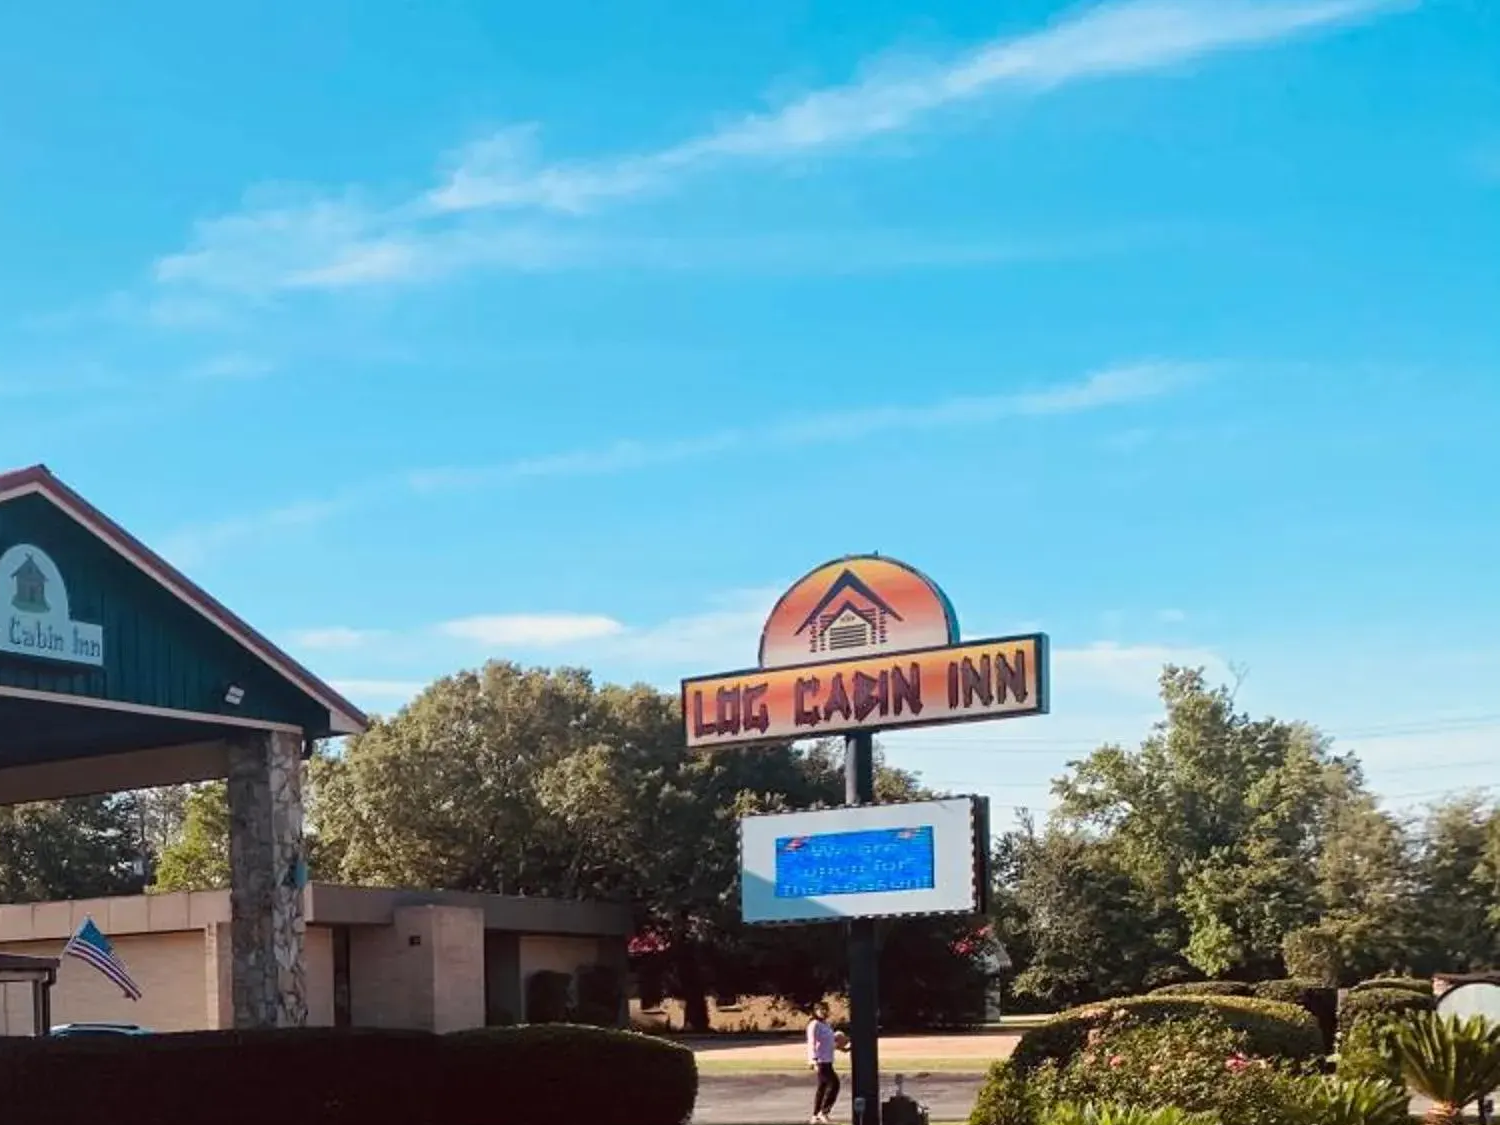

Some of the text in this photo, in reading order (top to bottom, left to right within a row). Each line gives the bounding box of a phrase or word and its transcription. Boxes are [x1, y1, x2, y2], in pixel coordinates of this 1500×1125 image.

[9, 614, 64, 652] Cabin
[73, 627, 101, 658] Inn
[692, 648, 1030, 738] LOG CABIN INN
